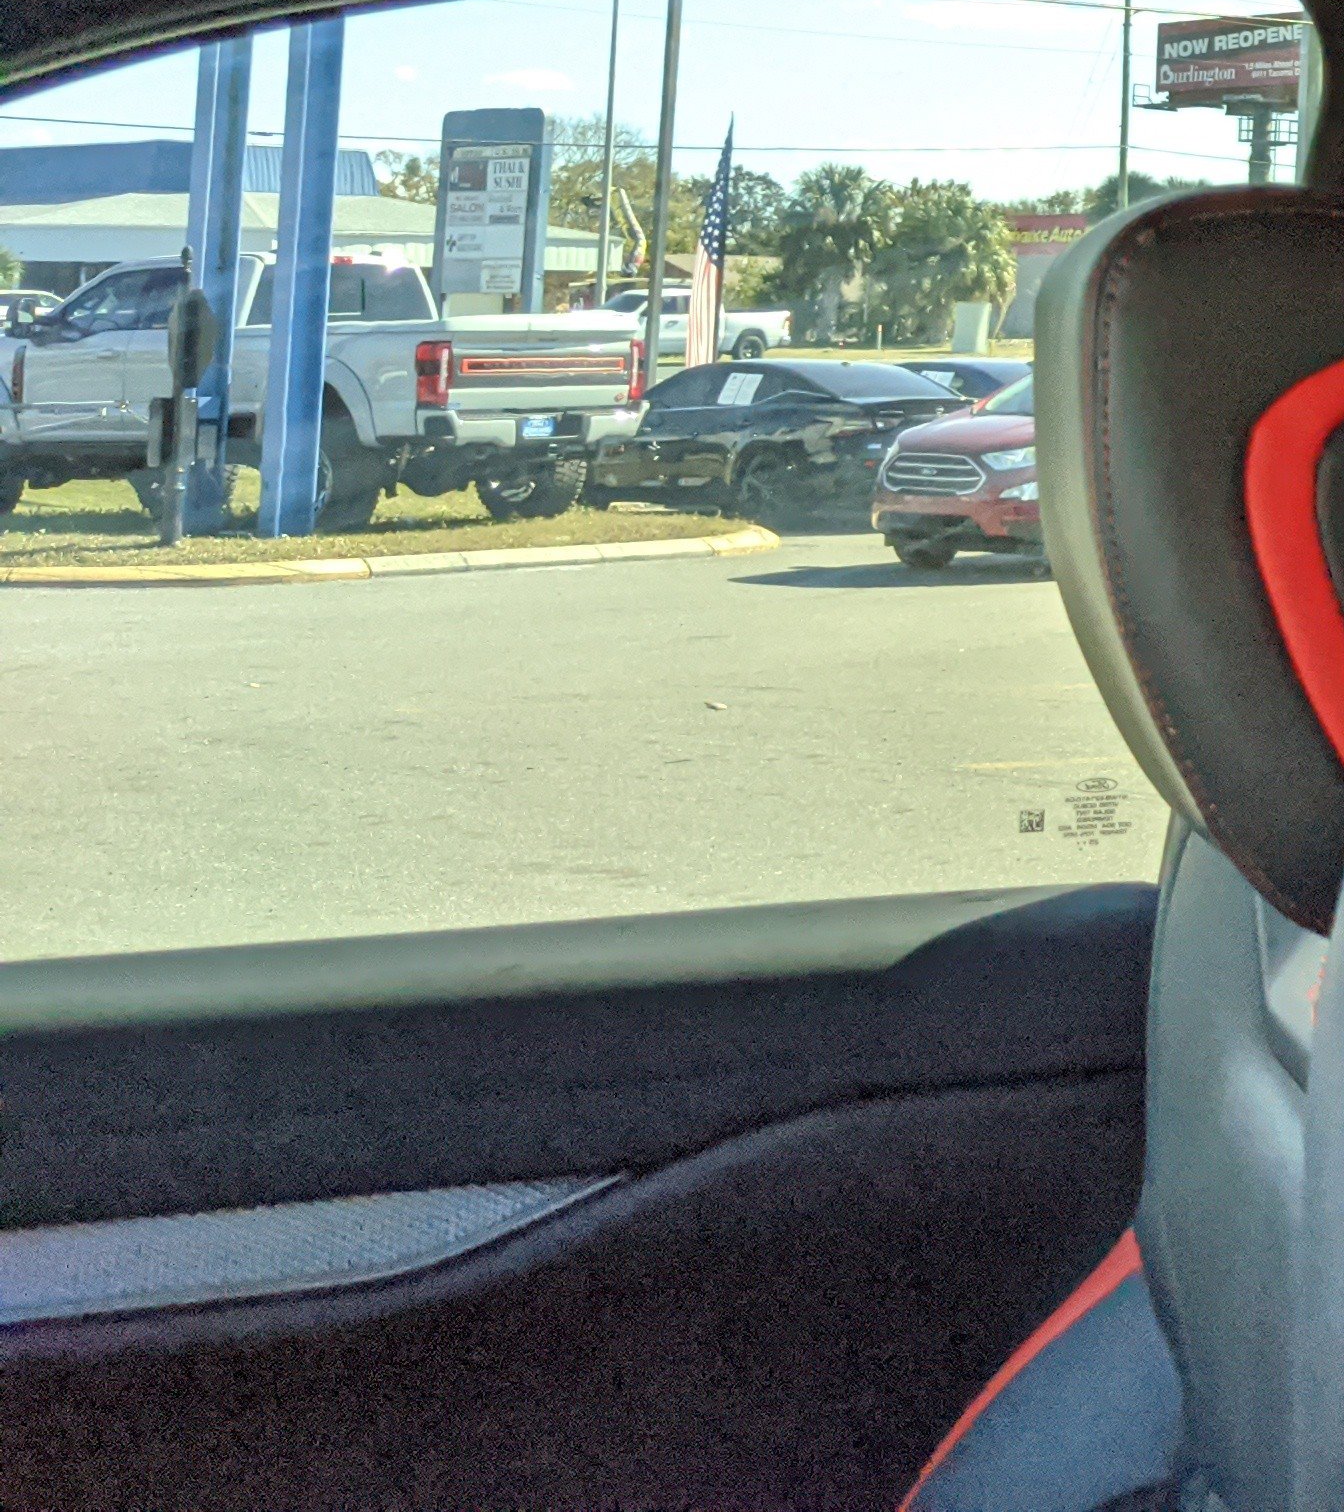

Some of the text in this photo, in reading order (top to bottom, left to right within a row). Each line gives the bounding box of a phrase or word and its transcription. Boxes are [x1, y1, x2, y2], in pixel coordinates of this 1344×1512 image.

[1164, 24, 1303, 59] NOW REOPENE
[1160, 64, 1236, 86] Burlington
[450, 202, 484, 213] SALON
